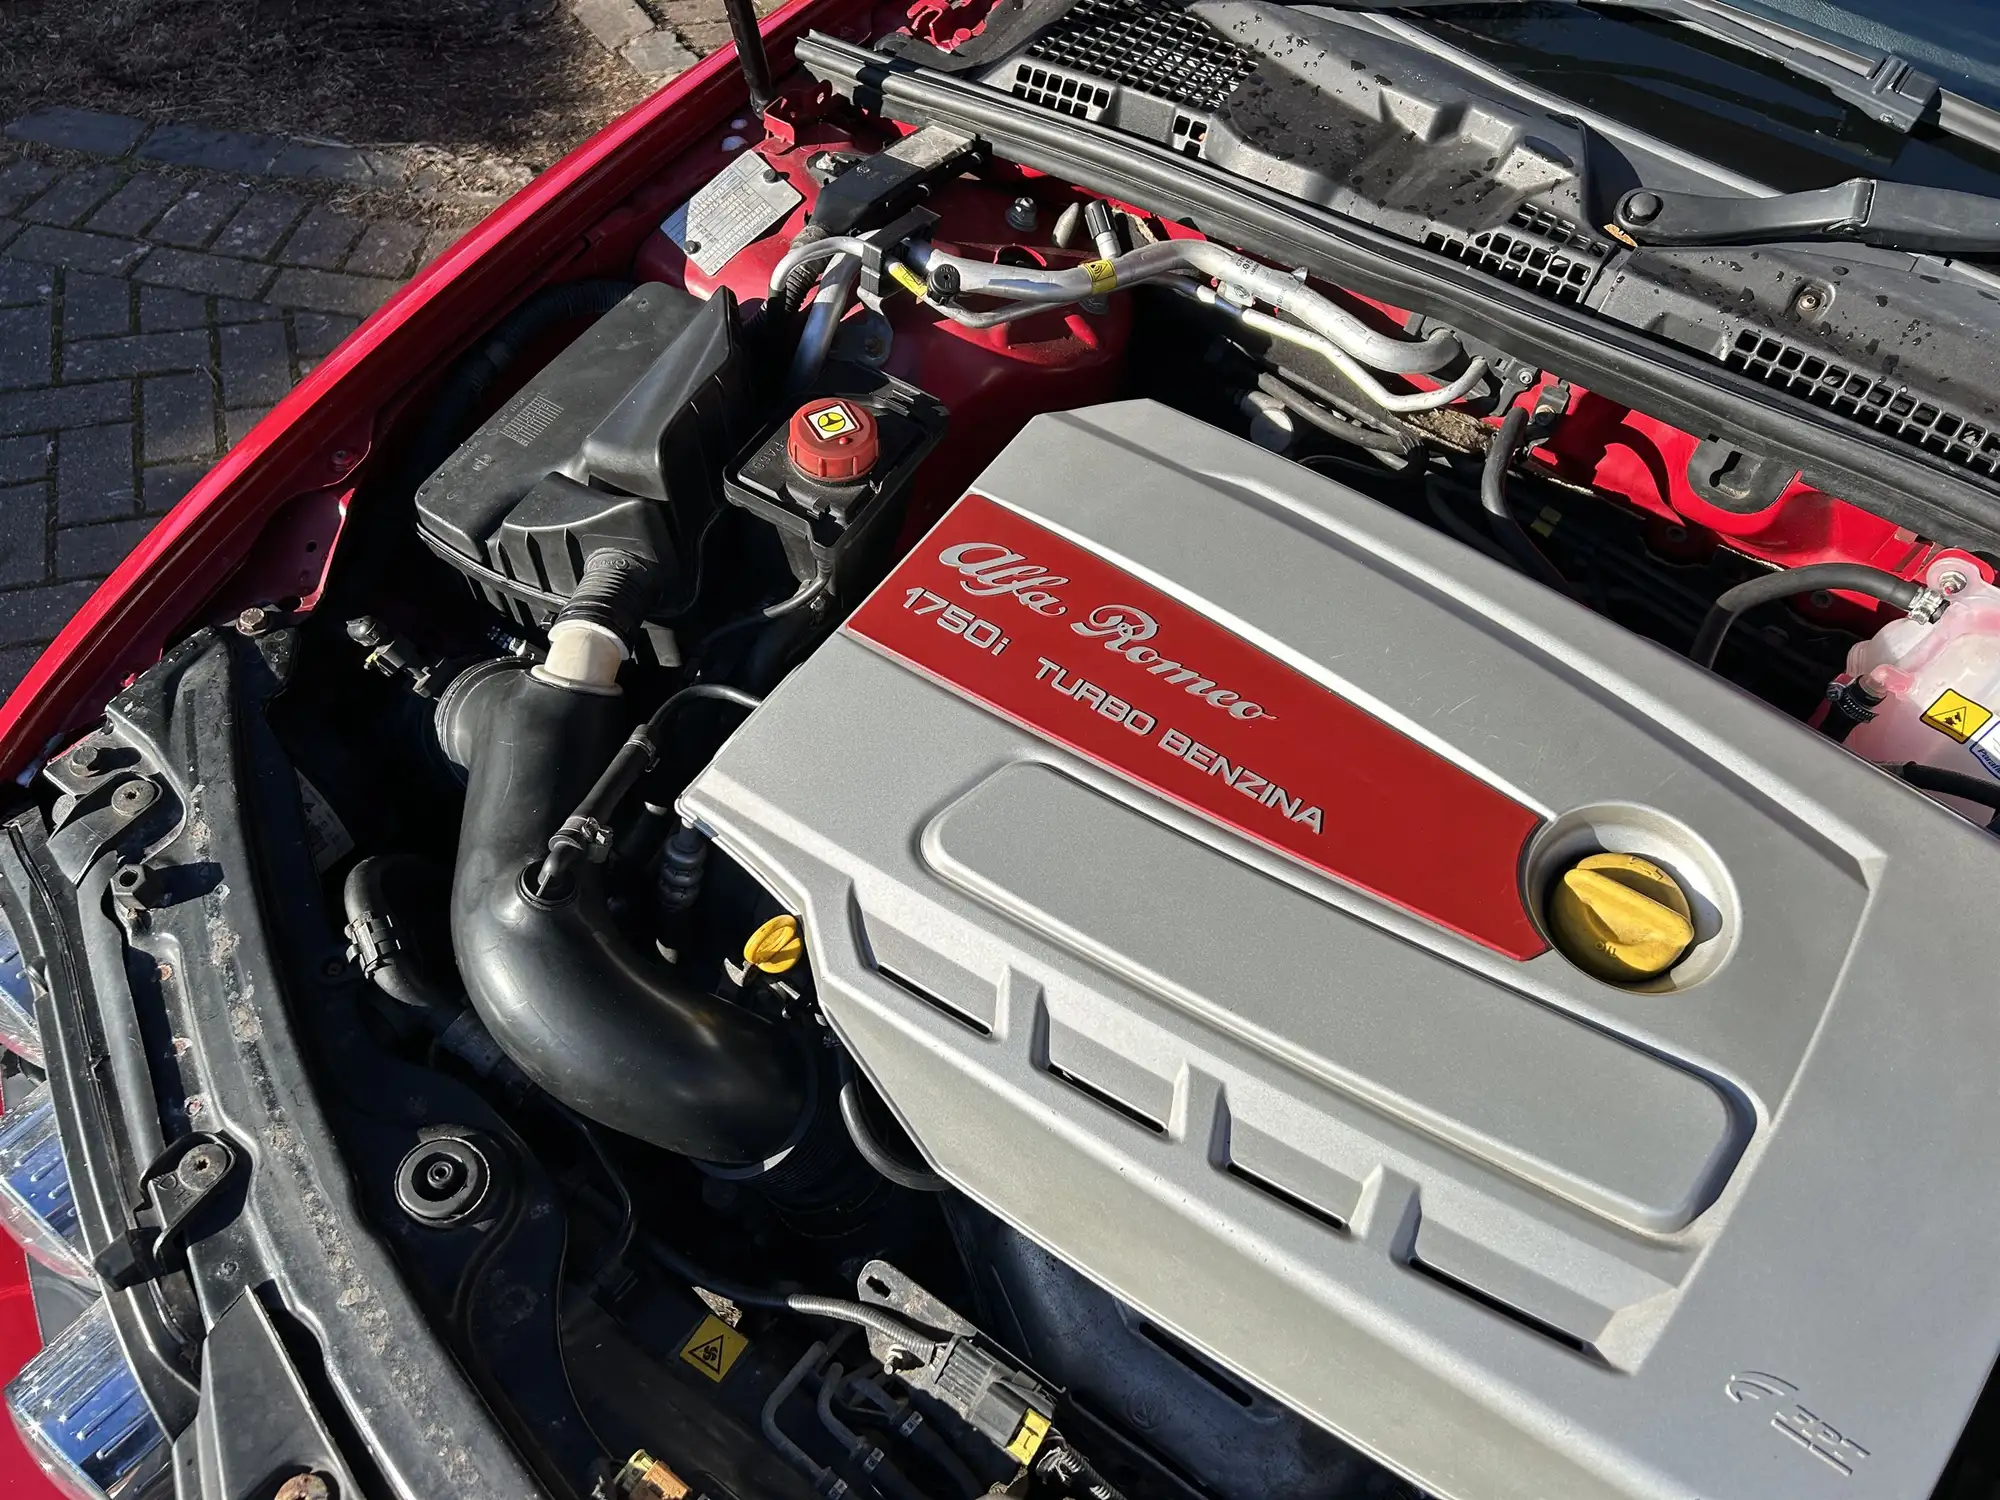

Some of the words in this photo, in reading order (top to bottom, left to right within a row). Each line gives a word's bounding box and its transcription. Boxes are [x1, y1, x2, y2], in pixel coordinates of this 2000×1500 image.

[902, 586, 1011, 656] 1750i
[1036, 656, 1157, 737] TURBO
[1158, 727, 1325, 836] BENZINA
[938, 541, 1069, 617] Alfa
[1070, 604, 1277, 722] Romeo
